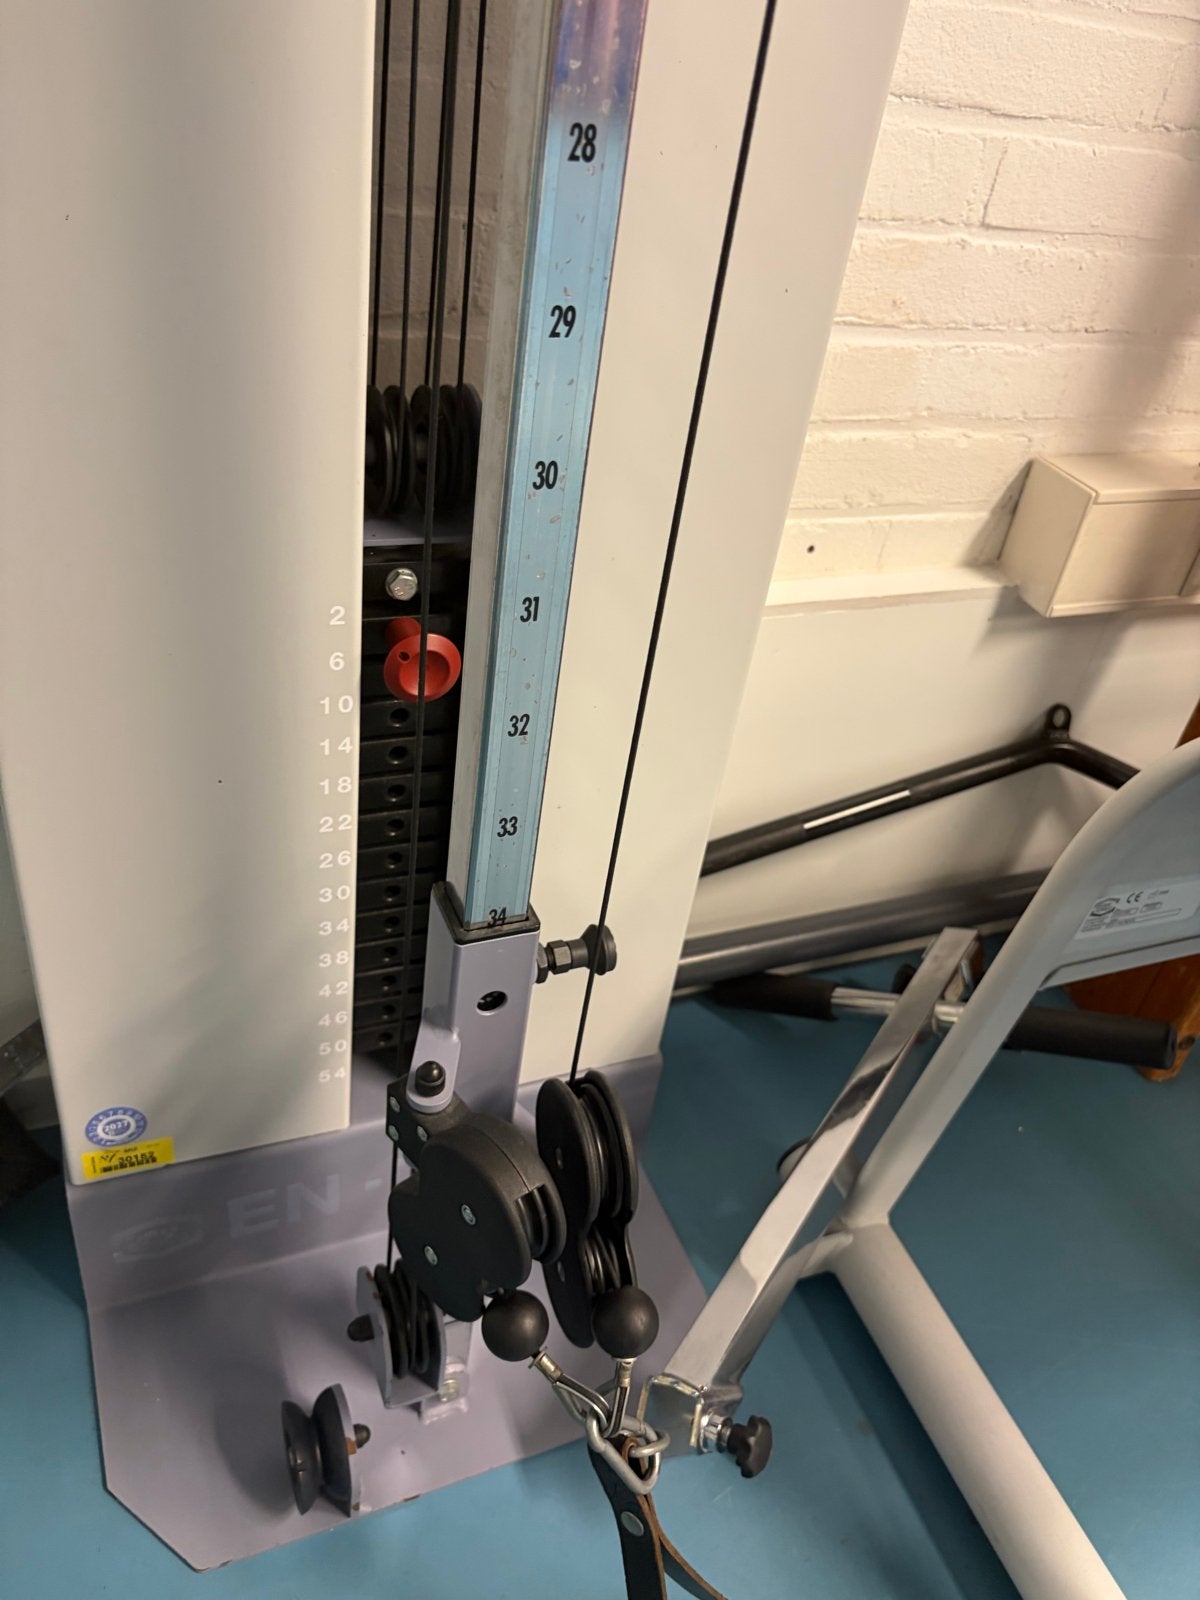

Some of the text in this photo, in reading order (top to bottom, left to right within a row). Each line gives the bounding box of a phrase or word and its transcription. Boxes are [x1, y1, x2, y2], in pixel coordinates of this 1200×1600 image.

[568, 122, 597, 163] 28
[548, 305, 576, 338] 29
[532, 460, 558, 490] 30
[329, 605, 346, 625] 2
[520, 596, 540, 623] 31
[329, 652, 345, 671] 6
[320, 695, 353, 714] 10
[507, 713, 530, 737] 32
[320, 736, 353, 756] 14
[319, 776, 352, 795] 18
[319, 814, 352, 833] 22
[496, 816, 518, 838] 33
[319, 850, 351, 869] 26
[318, 885, 351, 903] 30
[487, 906, 507, 928] 34
[318, 918, 350, 936] 34
[318, 950, 350, 968] 38
[318, 981, 349, 998] 42
[318, 1011, 348, 1027] 46
[318, 1039, 347, 1056] 50
[318, 1067, 347, 1083] 54
